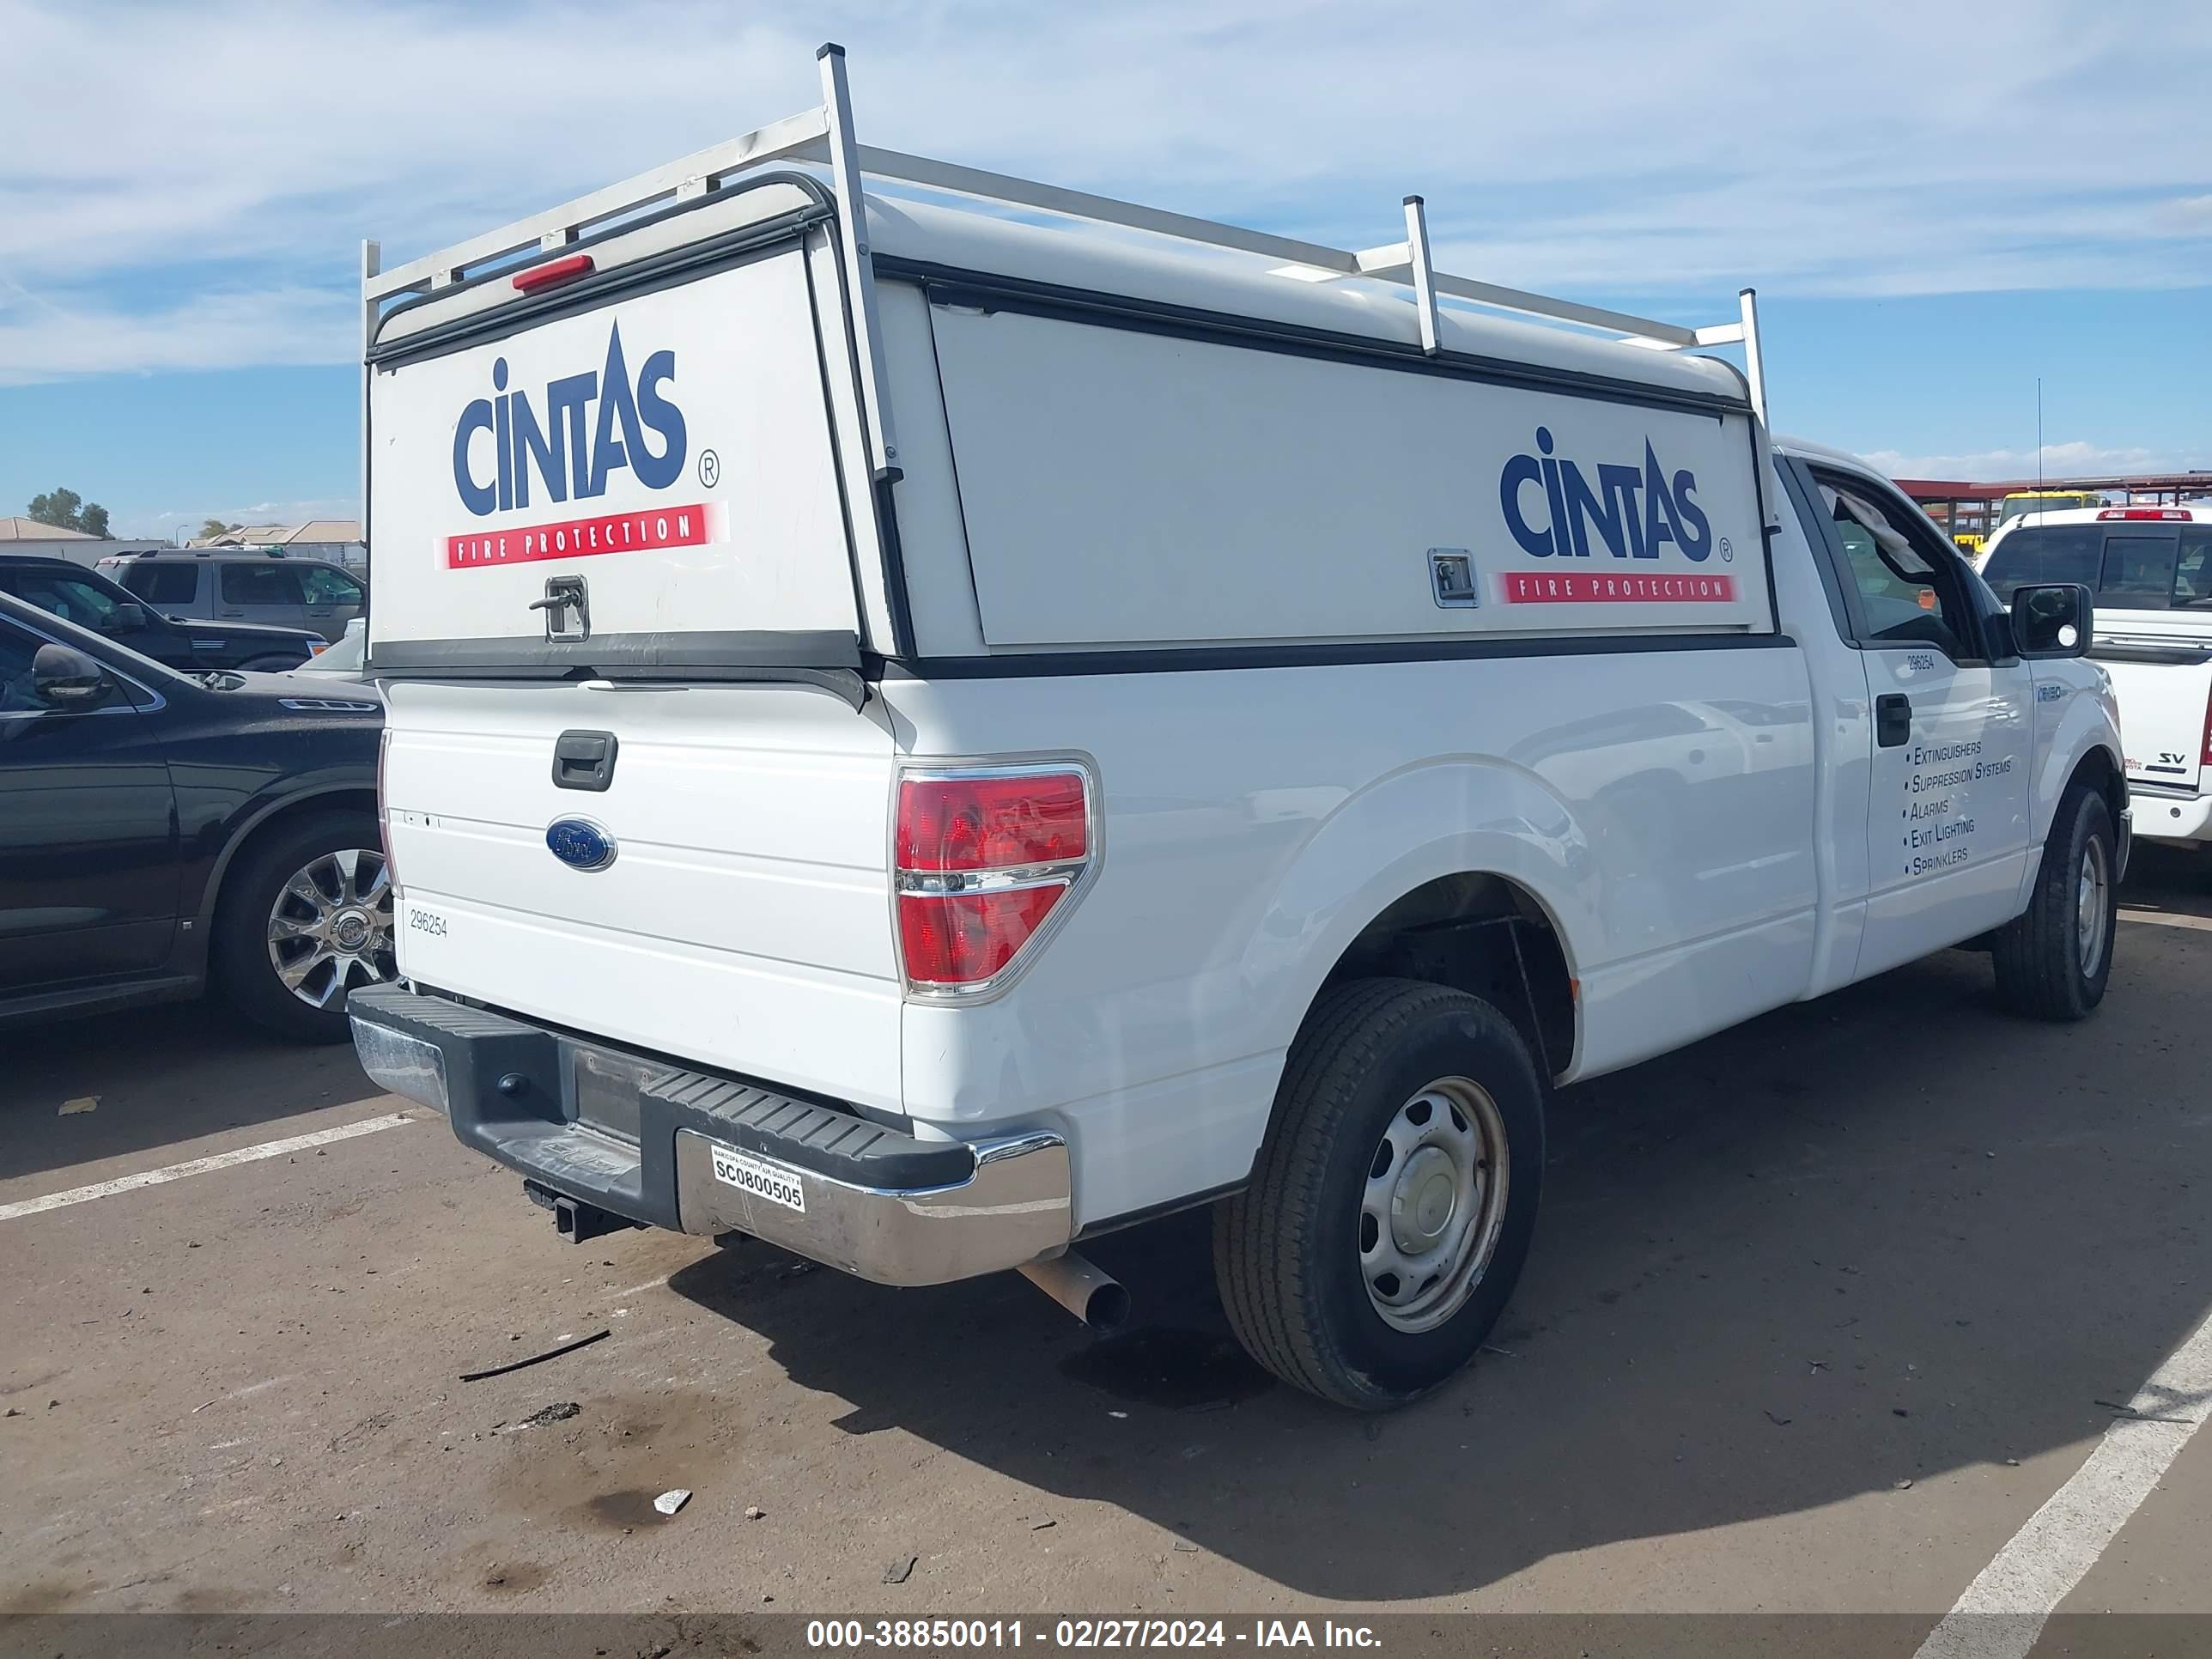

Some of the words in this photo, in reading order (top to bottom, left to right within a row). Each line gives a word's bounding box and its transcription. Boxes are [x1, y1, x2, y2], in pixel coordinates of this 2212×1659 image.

[458, 538, 507, 562] FIRE
[525, 514, 690, 555] PROTECTION
[1519, 579, 1573, 597] FIRE
[1592, 580, 1722, 596] PROTECTION
[1907, 654, 1935, 671] 296254
[1913, 741, 1982, 766] EXTINGUISHERS
[2158, 752, 2185, 764] SV
[1911, 768, 1974, 793] SUPPRESSION
[1975, 760, 2011, 780] SYSTEMS
[1910, 799, 1948, 822] ALARMS
[1911, 829, 1932, 848] EXIT
[1935, 818, 1975, 842] LIGHTING
[1913, 847, 1968, 876] SPRINKLERS
[410, 908, 447, 939] 296254
[714, 1149, 739, 1163] MARICOPA
[739, 1159, 761, 1170] COUNTY
[762, 1167, 772, 1176] AIR
[771, 1170, 795, 1182] QUALITY
[716, 1160, 802, 1206] SC0800505
